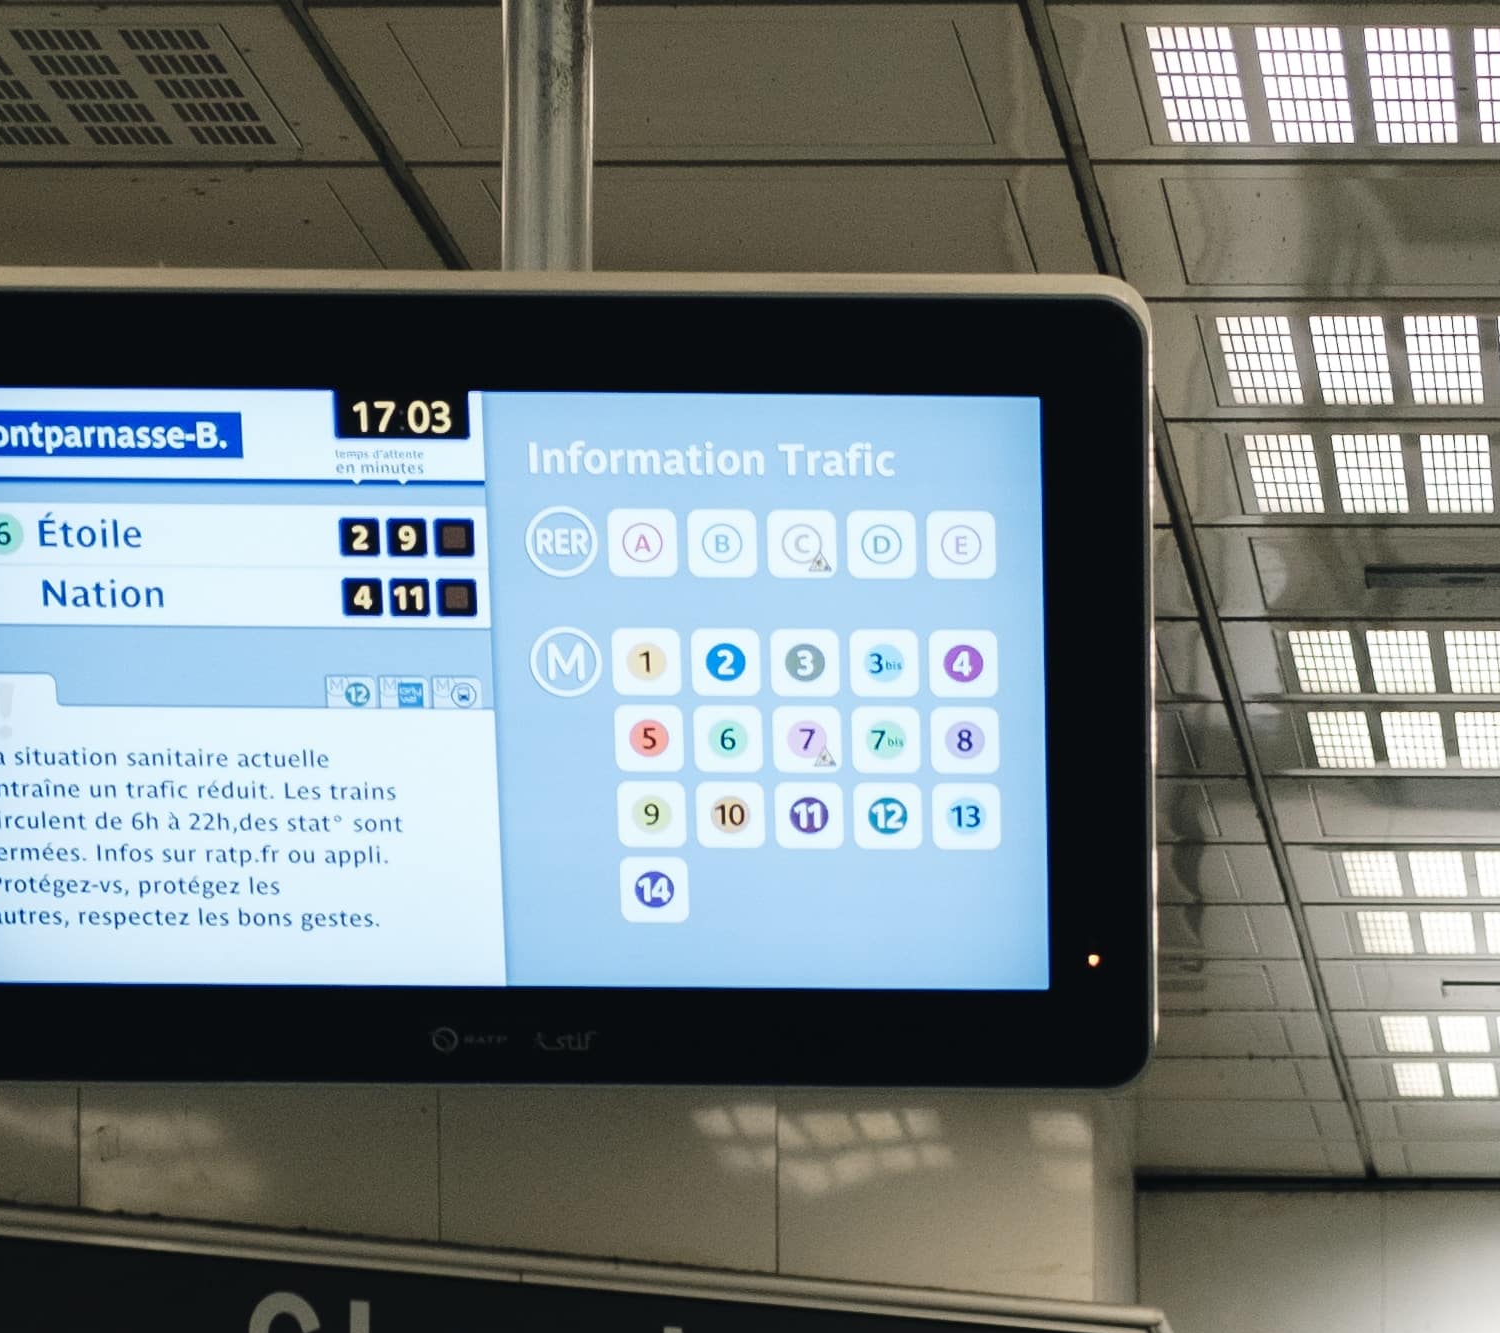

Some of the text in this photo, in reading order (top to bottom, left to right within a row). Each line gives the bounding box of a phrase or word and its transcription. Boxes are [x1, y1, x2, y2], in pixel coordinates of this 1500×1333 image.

[335, 461, 424, 474] en minutes
[528, 440, 896, 478] Information Trafic
[38, 513, 142, 548] Étoile
[351, 526, 369, 550] 2
[398, 526, 416, 551] 9
[534, 526, 968, 556] RER A B C D E
[41, 579, 424, 610] Nation 4 11
[546, 642, 973, 682] M 1 2 3 4
[642, 727, 973, 752] 5 6 7 8
[14, 747, 117, 768] situation
[126, 748, 229, 768] sanitaire
[237, 749, 329, 769] actuelle
[90, 784, 117, 799] un
[126, 780, 188, 800] trafic
[198, 781, 275, 801] réduit.
[284, 782, 321, 801] Les
[329, 783, 396, 802] trains
[96, 811, 122, 831] de
[131, 811, 159, 831] 6h
[167, 811, 181, 831] à
[353, 815, 403, 834] sont
[643, 802, 981, 830] 9 10 11 12 13
[96, 842, 154, 863] Infos
[163, 848, 196, 864] sur
[205, 844, 279, 869] ratp.fr
[289, 848, 315, 864] ou
[324, 845, 389, 869] appli.
[139, 876, 240, 900] protégez
[249, 876, 280, 896] les
[636, 876, 671, 903] 14
[78, 909, 190, 932] respectez
[198, 908, 229, 927] les
[238, 909, 292, 928] bons
[301, 910, 381, 931] gestes.
